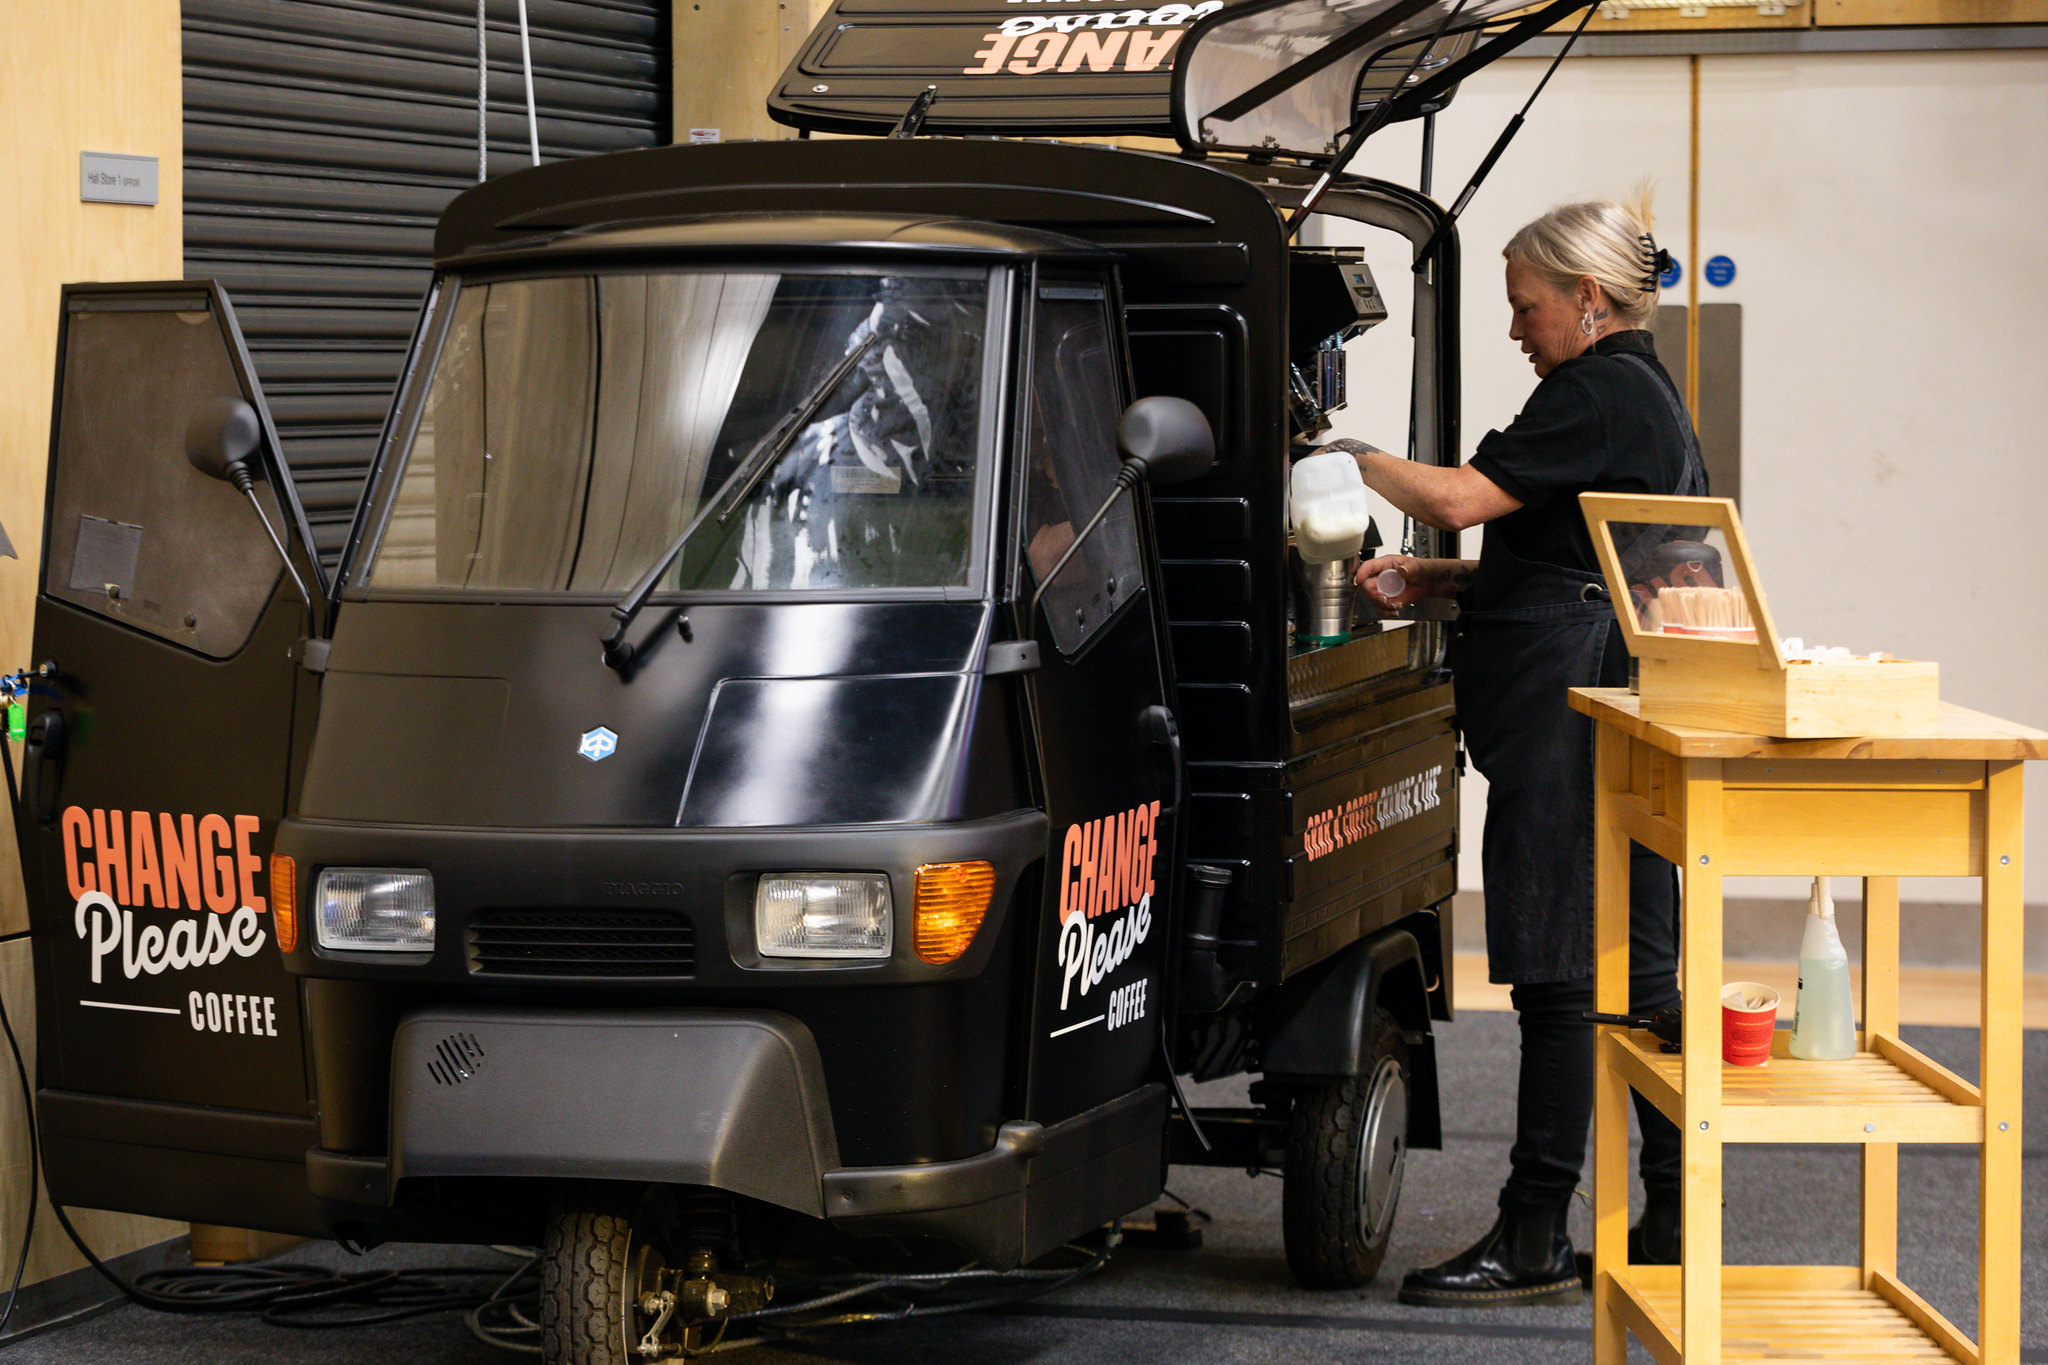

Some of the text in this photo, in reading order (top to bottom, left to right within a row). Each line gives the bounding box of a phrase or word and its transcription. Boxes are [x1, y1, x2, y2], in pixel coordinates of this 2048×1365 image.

[997, 0, 1224, 37] ease
[963, 29, 1185, 75] ANGE
[62, 805, 267, 914] CHANGE
[1059, 799, 1161, 928] CHANGE
[602, 881, 685, 896] PIAGGIO
[75, 890, 267, 984] Please
[1058, 892, 1152, 1011] Please
[188, 990, 278, 1037] COFFEE
[1107, 978, 1148, 1032] COFFEE
